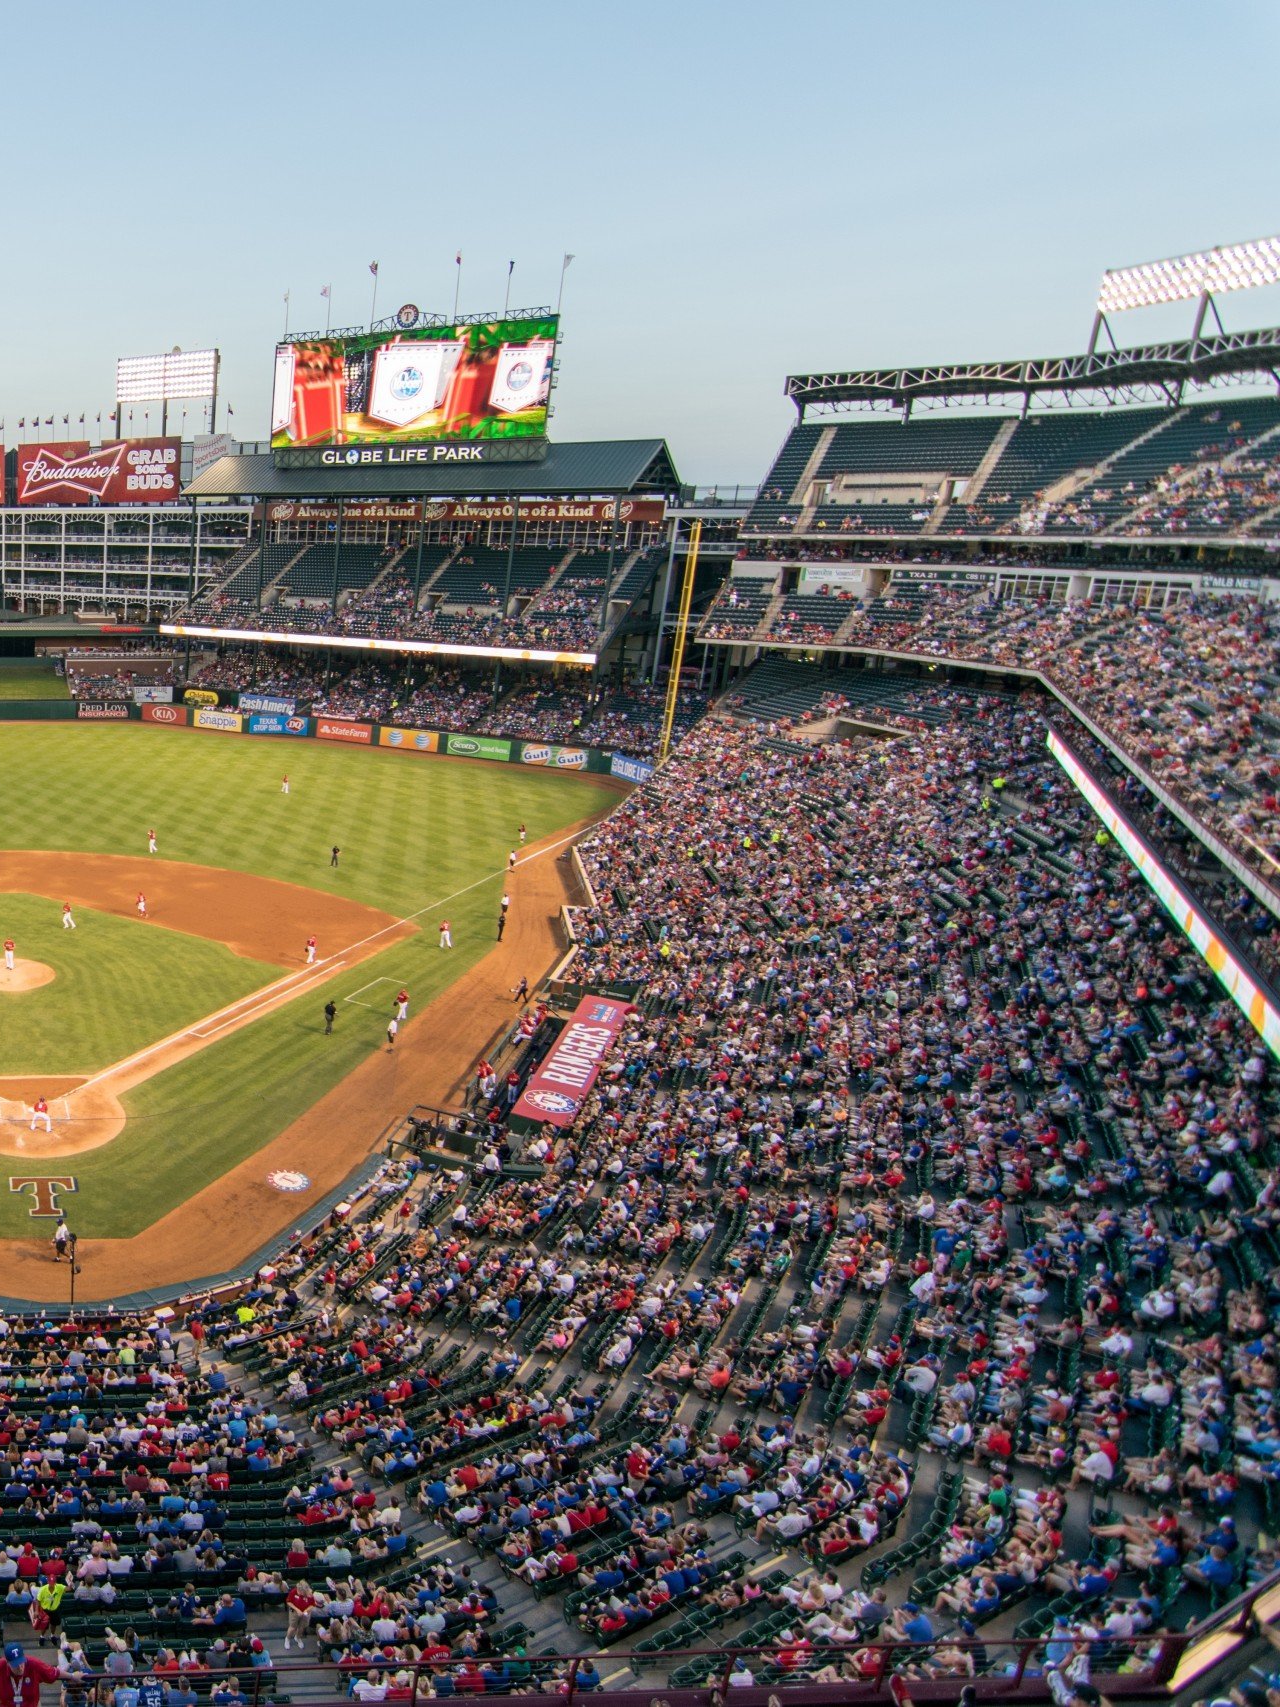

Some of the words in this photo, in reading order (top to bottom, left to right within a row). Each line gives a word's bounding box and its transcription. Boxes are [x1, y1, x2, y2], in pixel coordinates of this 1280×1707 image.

[126, 448, 176, 466] GRAB
[194, 445, 226, 464] SportsDay
[388, 448, 427, 462] LIFE
[432, 446, 483, 461] PARK
[22, 460, 120, 482] Budweiser
[134, 464, 166, 474] SOME
[126, 474, 174, 490] BUDS
[297, 506, 338, 517] Always
[364, 505, 377, 516] of
[377, 508, 385, 516] a
[386, 505, 416, 516] Kind
[452, 505, 500, 518] Always
[532, 504, 545, 516] of
[546, 508, 555, 516] a
[556, 504, 594, 516] Kind
[1212, 578, 1234, 588] MLB
[79, 702, 102, 711] FRED
[104, 702, 127, 711] LOYA
[156, 710, 173, 719] KIA
[199, 712, 236, 728] Snapple
[453, 742, 475, 750] Scotts
[524, 750, 550, 760] Gulf
[557, 754, 584, 764] Gulf
[618, 759, 637, 778] GLOBE
[637, 766, 652, 781] LIF
[541, 1023, 612, 1088] RANGERS
[9, 1176, 79, 1218] T
[12, 1648, 19, 1657] T
[147, 1698, 161, 1707] 56
